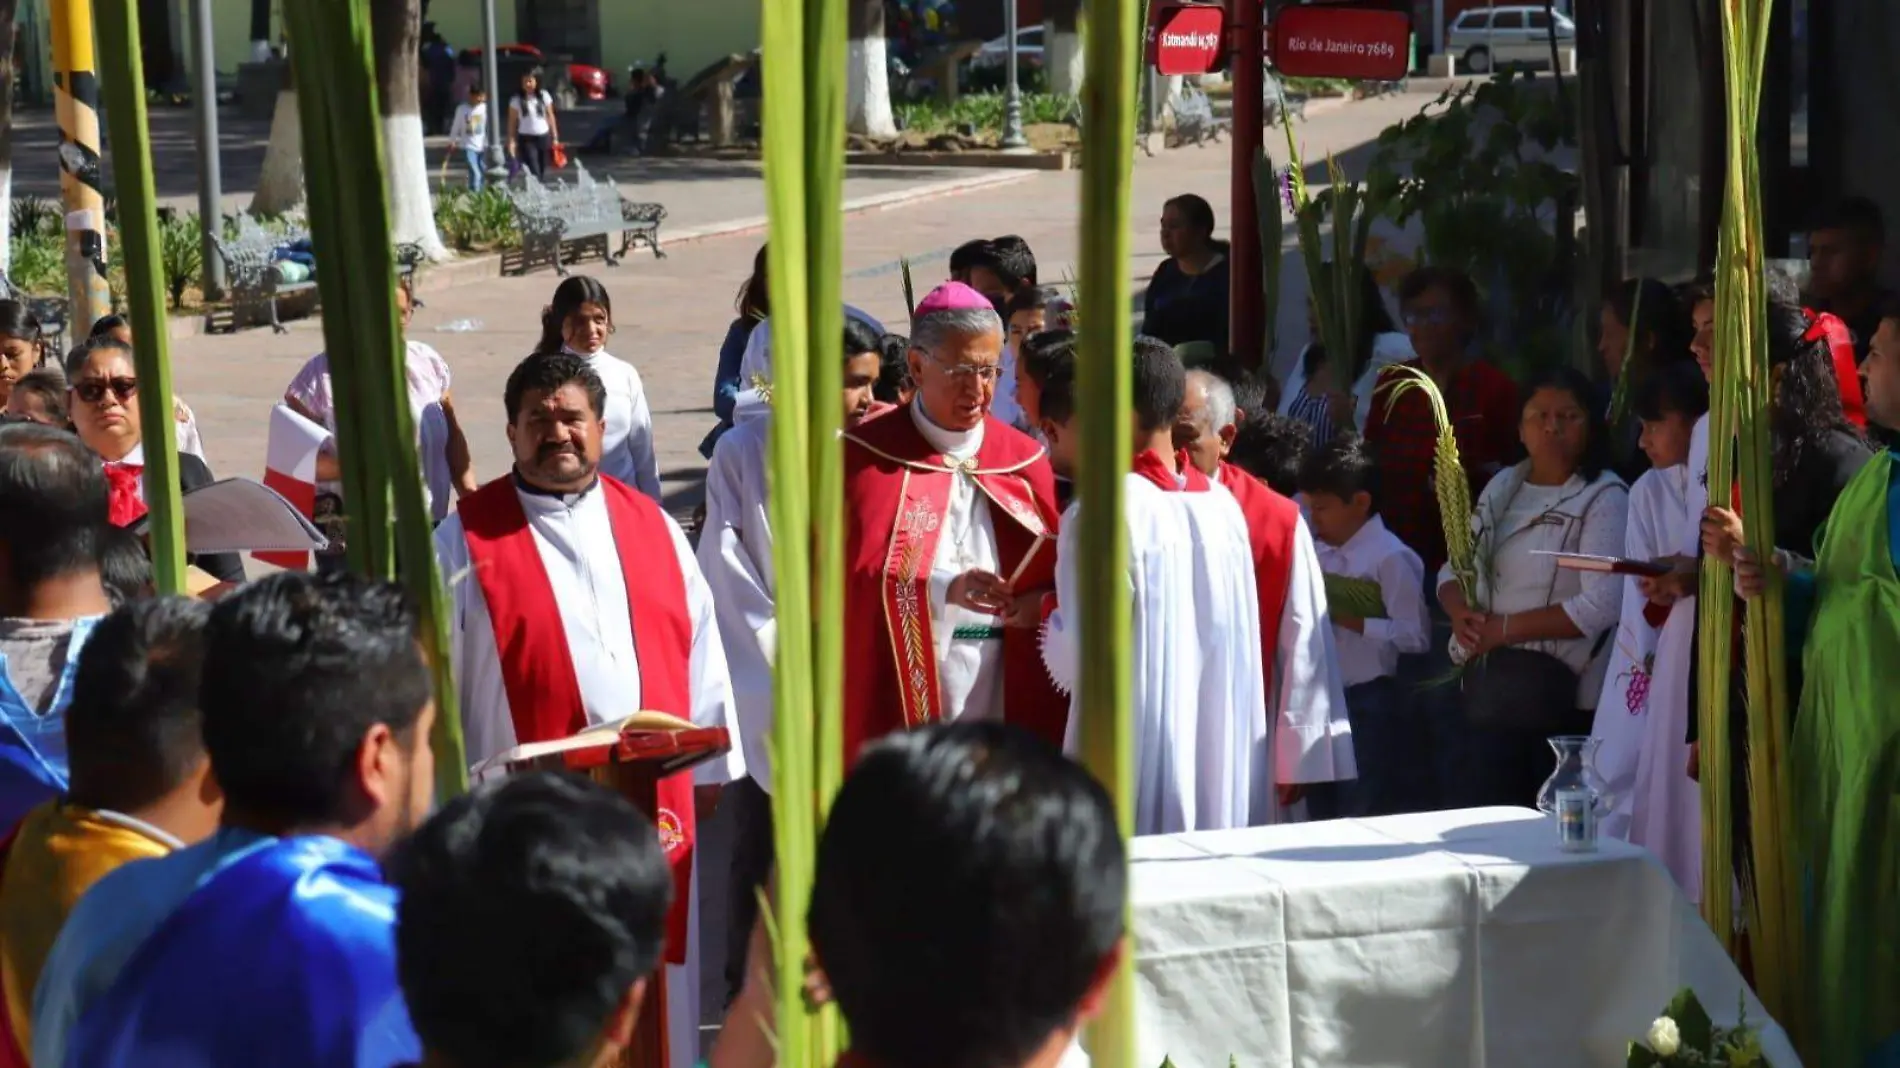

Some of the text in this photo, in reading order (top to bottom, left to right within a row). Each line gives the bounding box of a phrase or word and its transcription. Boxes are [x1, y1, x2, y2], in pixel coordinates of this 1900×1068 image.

[1309, 38, 1322, 52] de
[1325, 39, 1364, 54] Janeiro
[1367, 42, 1395, 59] 7689
